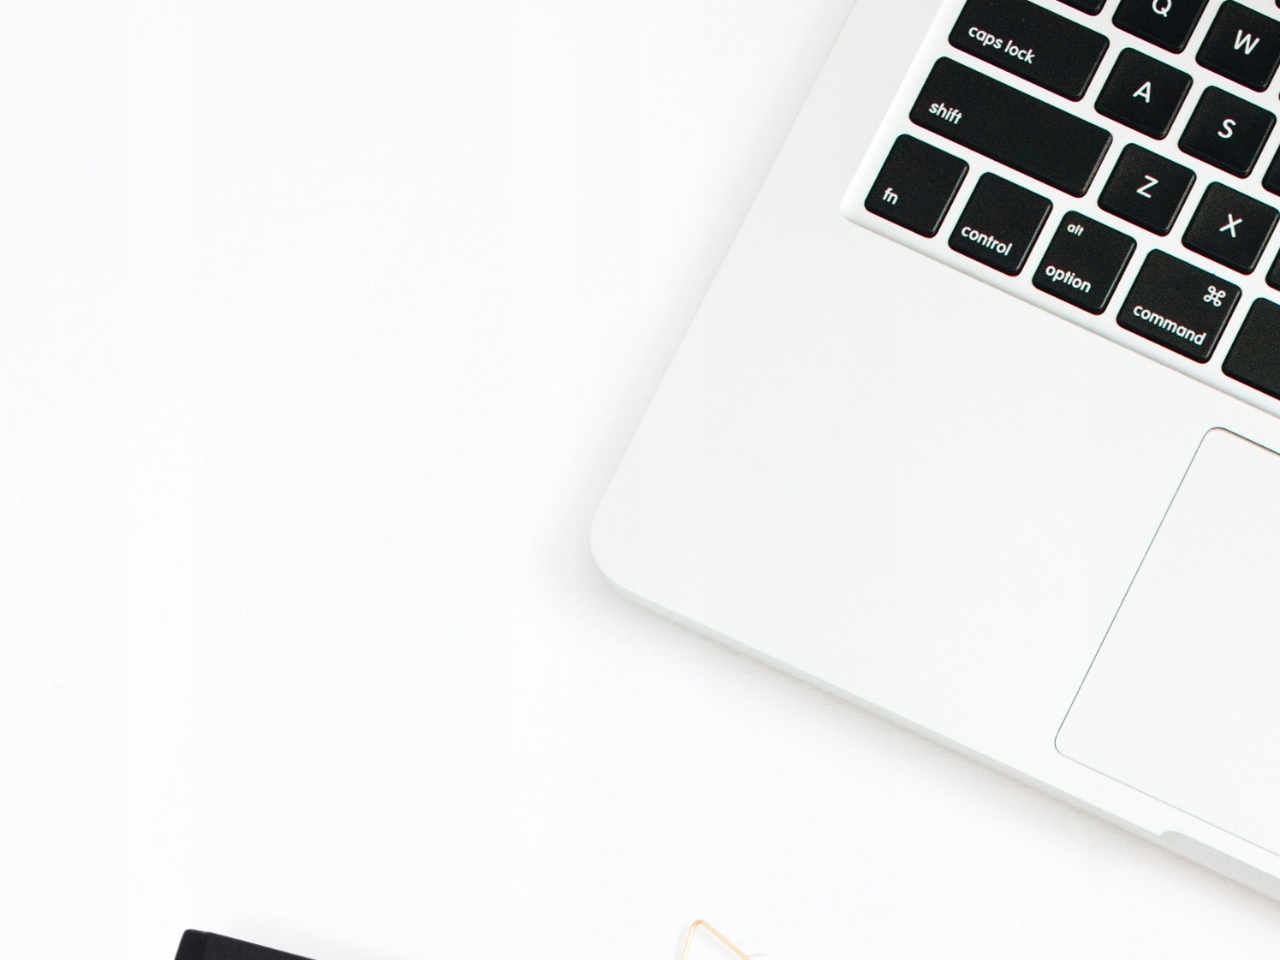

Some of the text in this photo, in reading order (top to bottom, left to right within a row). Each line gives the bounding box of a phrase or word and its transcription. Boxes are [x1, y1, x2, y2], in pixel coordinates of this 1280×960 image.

[1152, 0, 1171, 17] Q
[969, 27, 1035, 64] caps lock
[1234, 30, 1260, 54] W
[1133, 82, 1151, 103] A
[929, 103, 962, 124] shift
[1218, 119, 1236, 138] S
[883, 188, 898, 204] fn
[1137, 175, 1158, 198] Z
[1067, 224, 1083, 236] alt
[1220, 214, 1242, 237] X
[961, 224, 1013, 256] control
[1045, 263, 1092, 294] option
[1133, 303, 1206, 346] command
